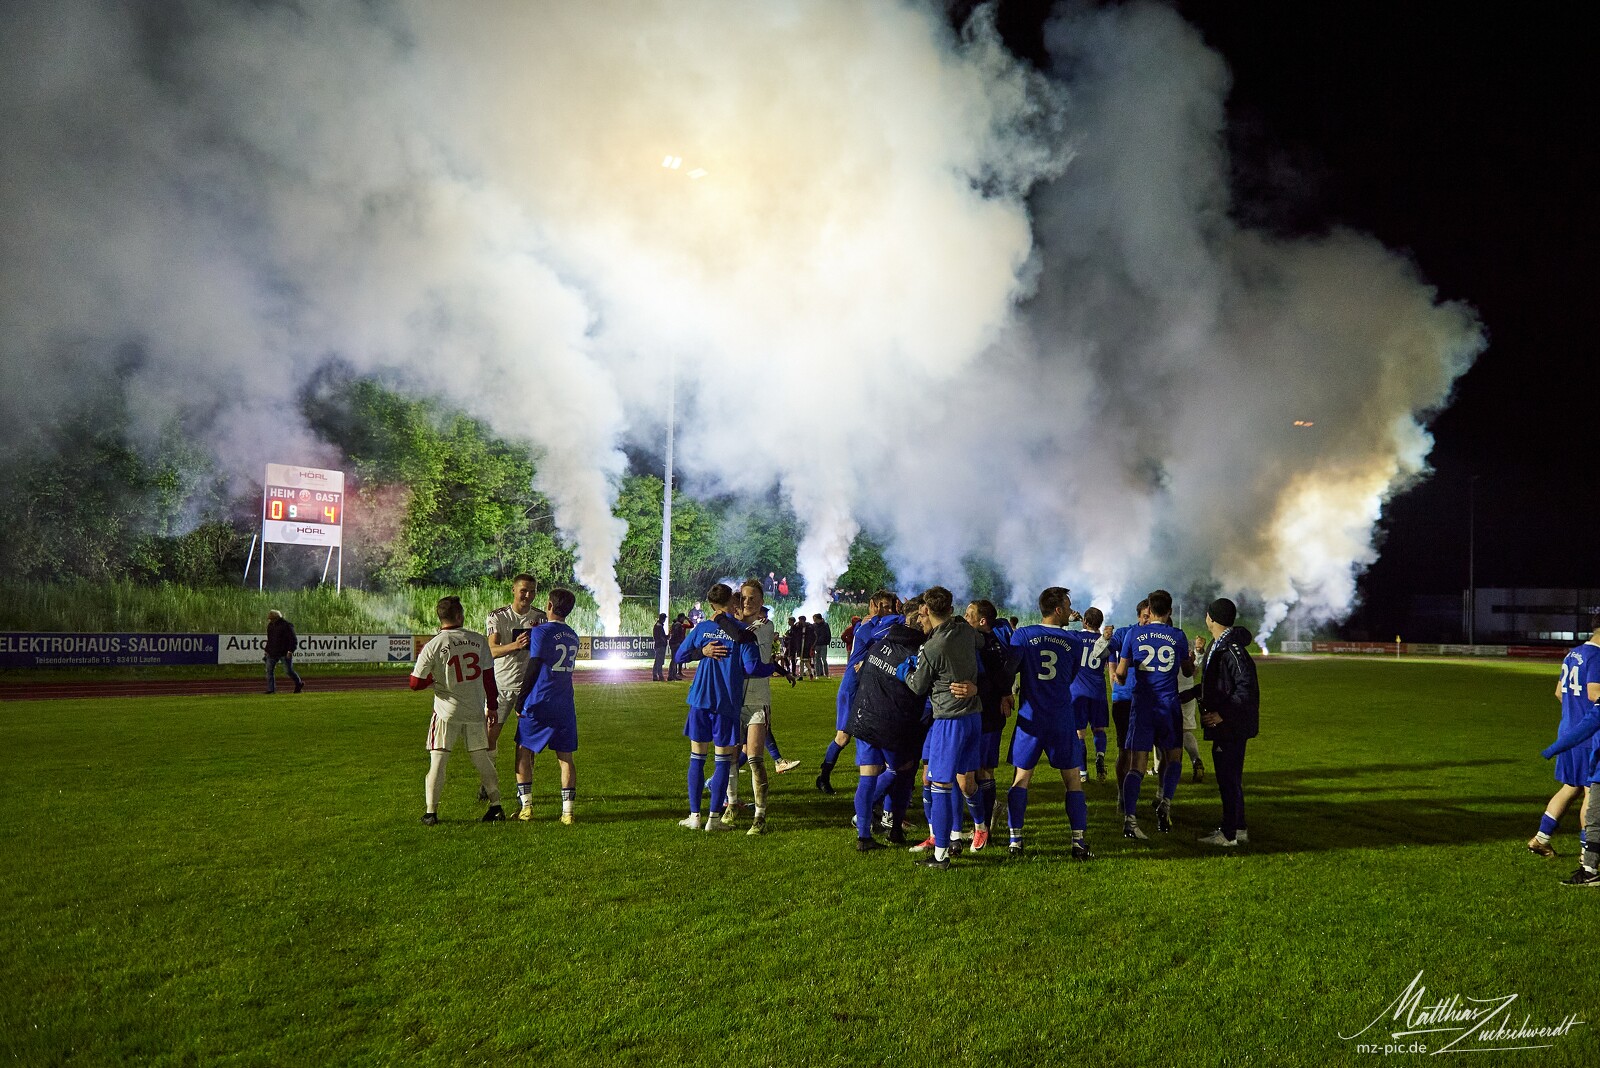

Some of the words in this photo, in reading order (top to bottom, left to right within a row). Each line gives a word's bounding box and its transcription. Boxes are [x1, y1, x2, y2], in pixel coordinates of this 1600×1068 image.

[299, 471, 327, 480] HÖRL
[270, 487, 295, 499] HEIM
[315, 492, 340, 503] GAST
[271, 500, 283, 520] 0
[289, 505, 297, 517] 9
[324, 506, 335, 523] 4
[297, 526, 325, 534] HÖRL
[453, 639, 481, 649] Laufen
[593, 638, 631, 650] Gasthaus
[1029, 635, 1042, 646] TSV
[1043, 635, 1072, 652] Fridolfing
[1136, 633, 1149, 643] TSV
[1150, 633, 1177, 646] Fridolfing
[551, 643, 578, 673] 23
[880, 644, 893, 657] TSV
[1080, 646, 1101, 670] 16
[1138, 644, 1175, 673] 29
[102, 656, 111, 664] 15
[116, 655, 138, 664] 83410
[139, 655, 161, 663] Laufen
[447, 652, 482, 683] 13
[1037, 650, 1059, 681] 3
[1561, 663, 1583, 697] 24
